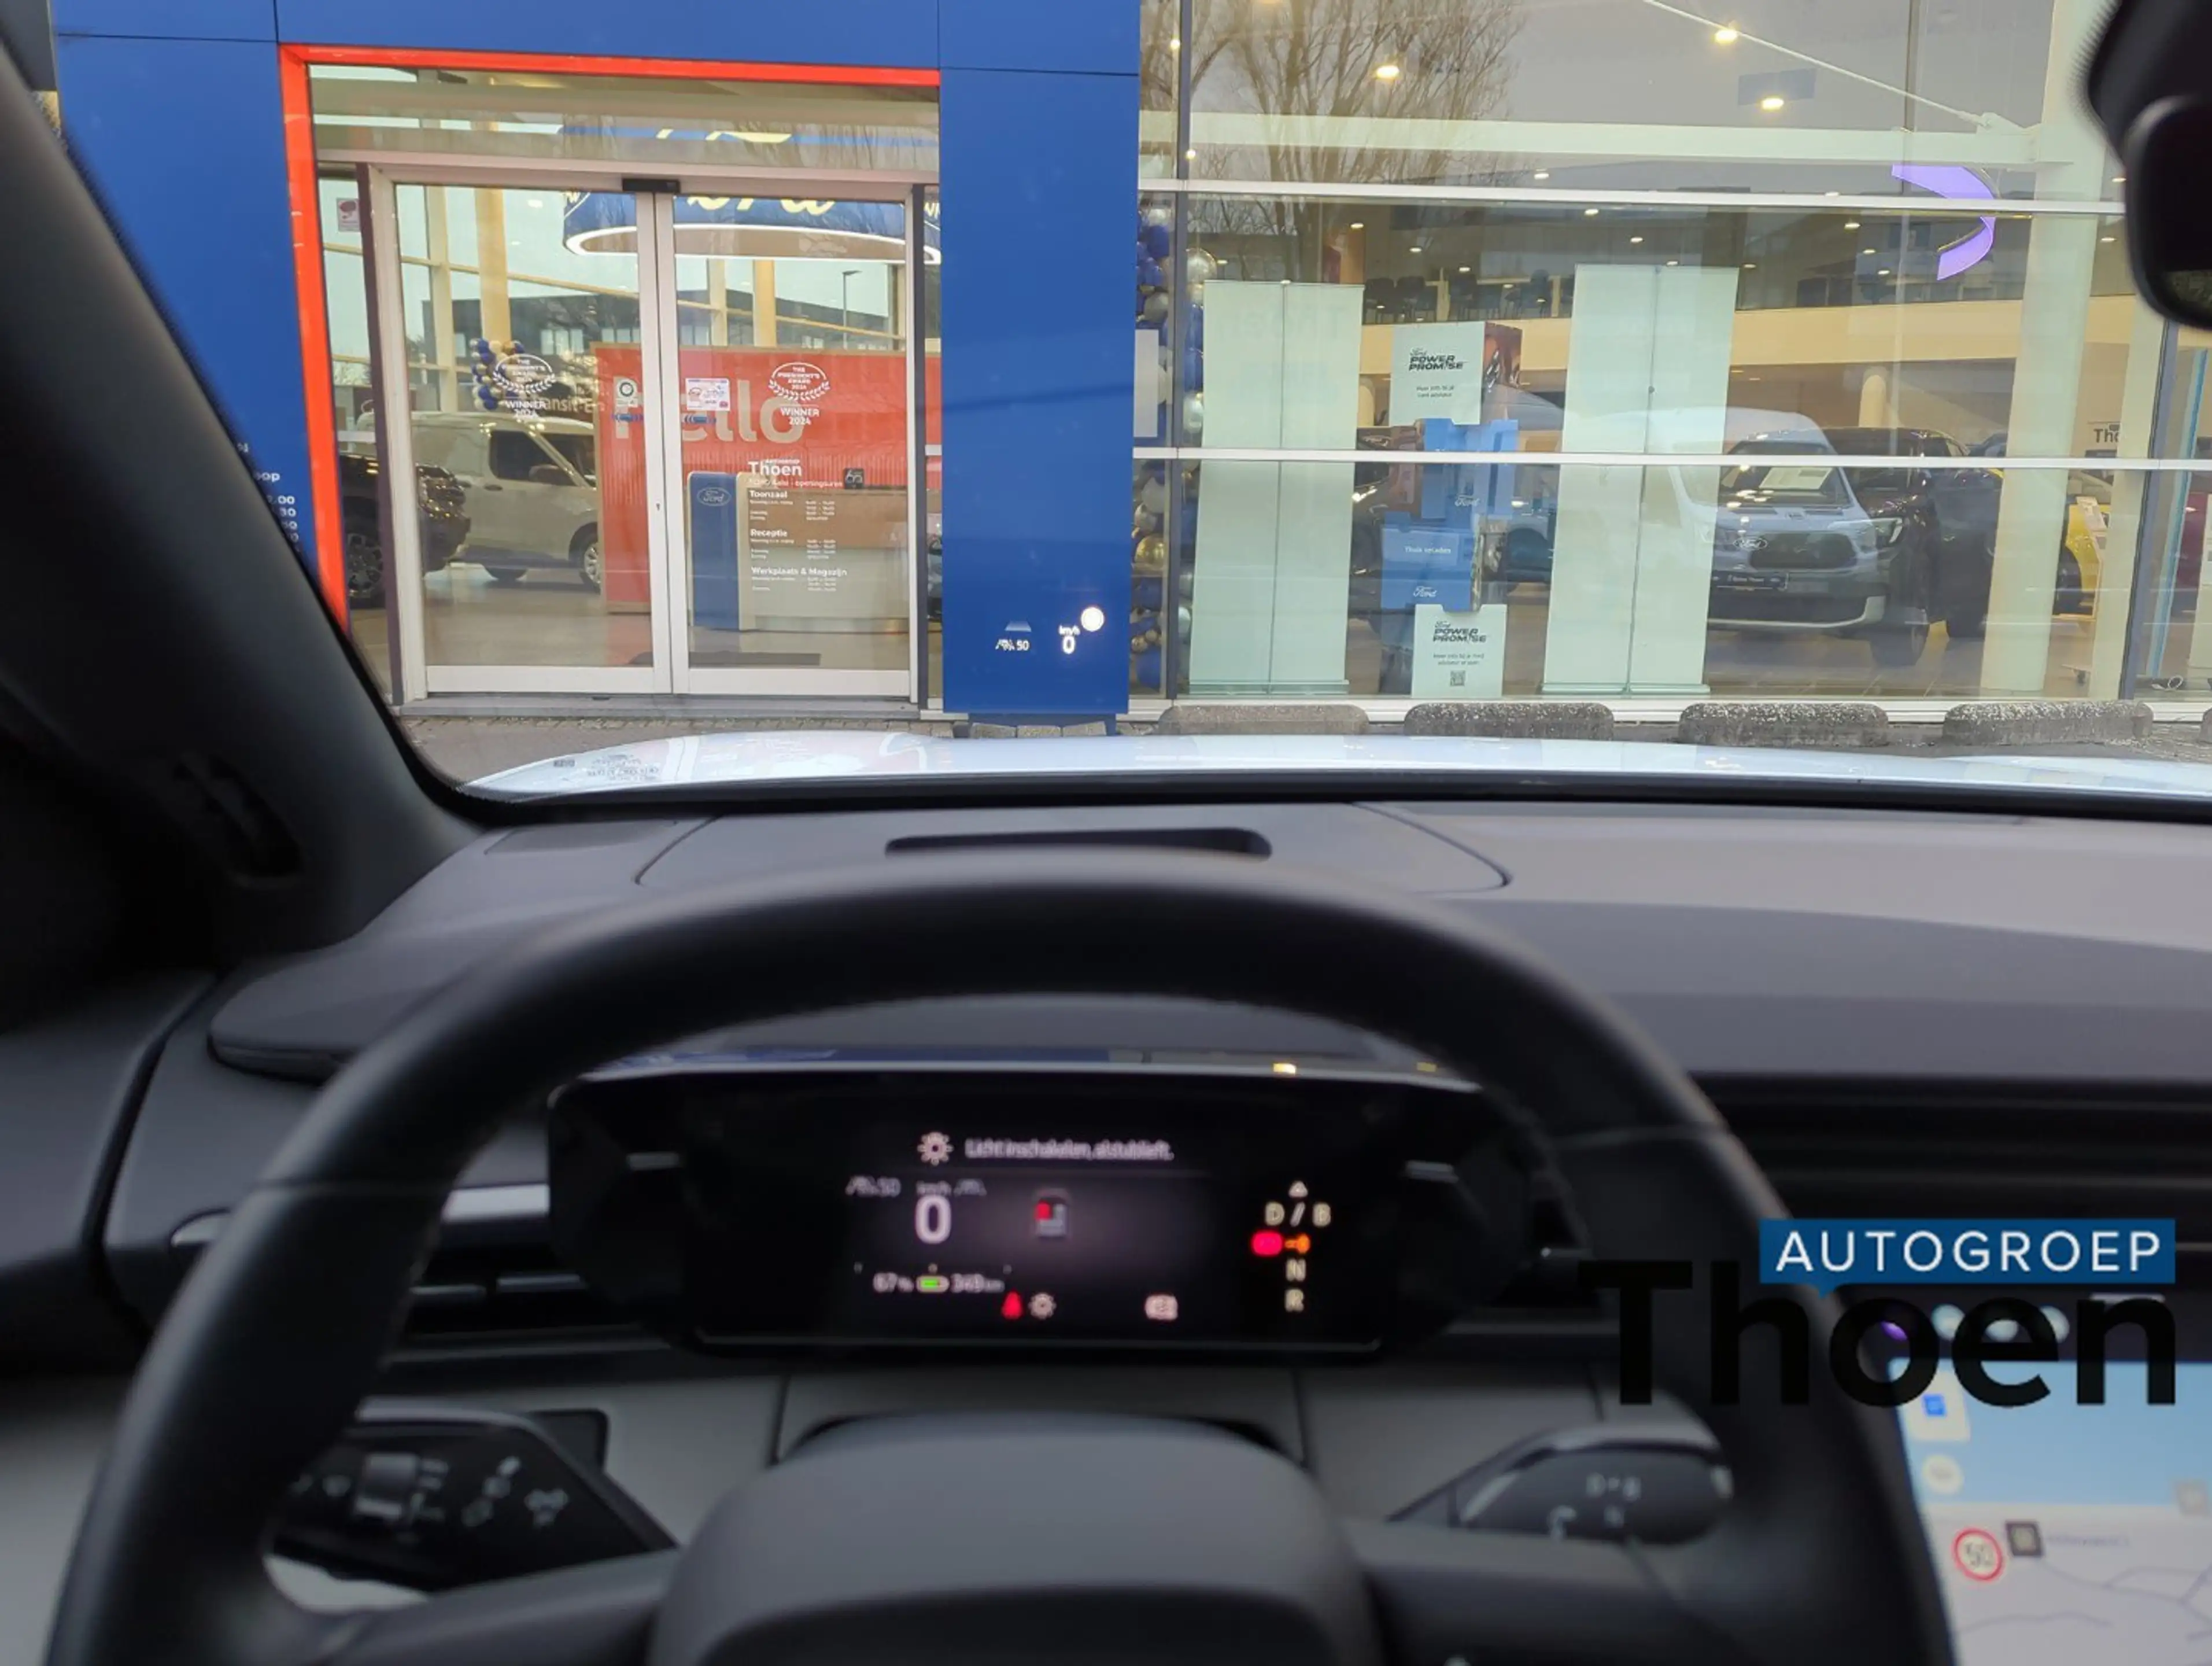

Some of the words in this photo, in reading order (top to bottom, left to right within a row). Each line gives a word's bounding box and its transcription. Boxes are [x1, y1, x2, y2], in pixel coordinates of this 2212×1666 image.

[1410, 355, 1456, 363] POWER
[781, 408, 820, 417] WINNER
[789, 417, 811, 425] 2024
[748, 461, 802, 476] Thoen
[750, 529, 788, 537] Receptie
[751, 566, 799, 576] Werkplaats
[808, 567, 848, 577] Magazijn
[1017, 639, 1030, 651] 50
[1063, 636, 1076, 655] 0
[915, 1194, 952, 1244] 0
[1265, 1201, 1285, 1226] D
[1286, 1258, 1306, 1282] N
[1284, 1288, 1305, 1312] R
